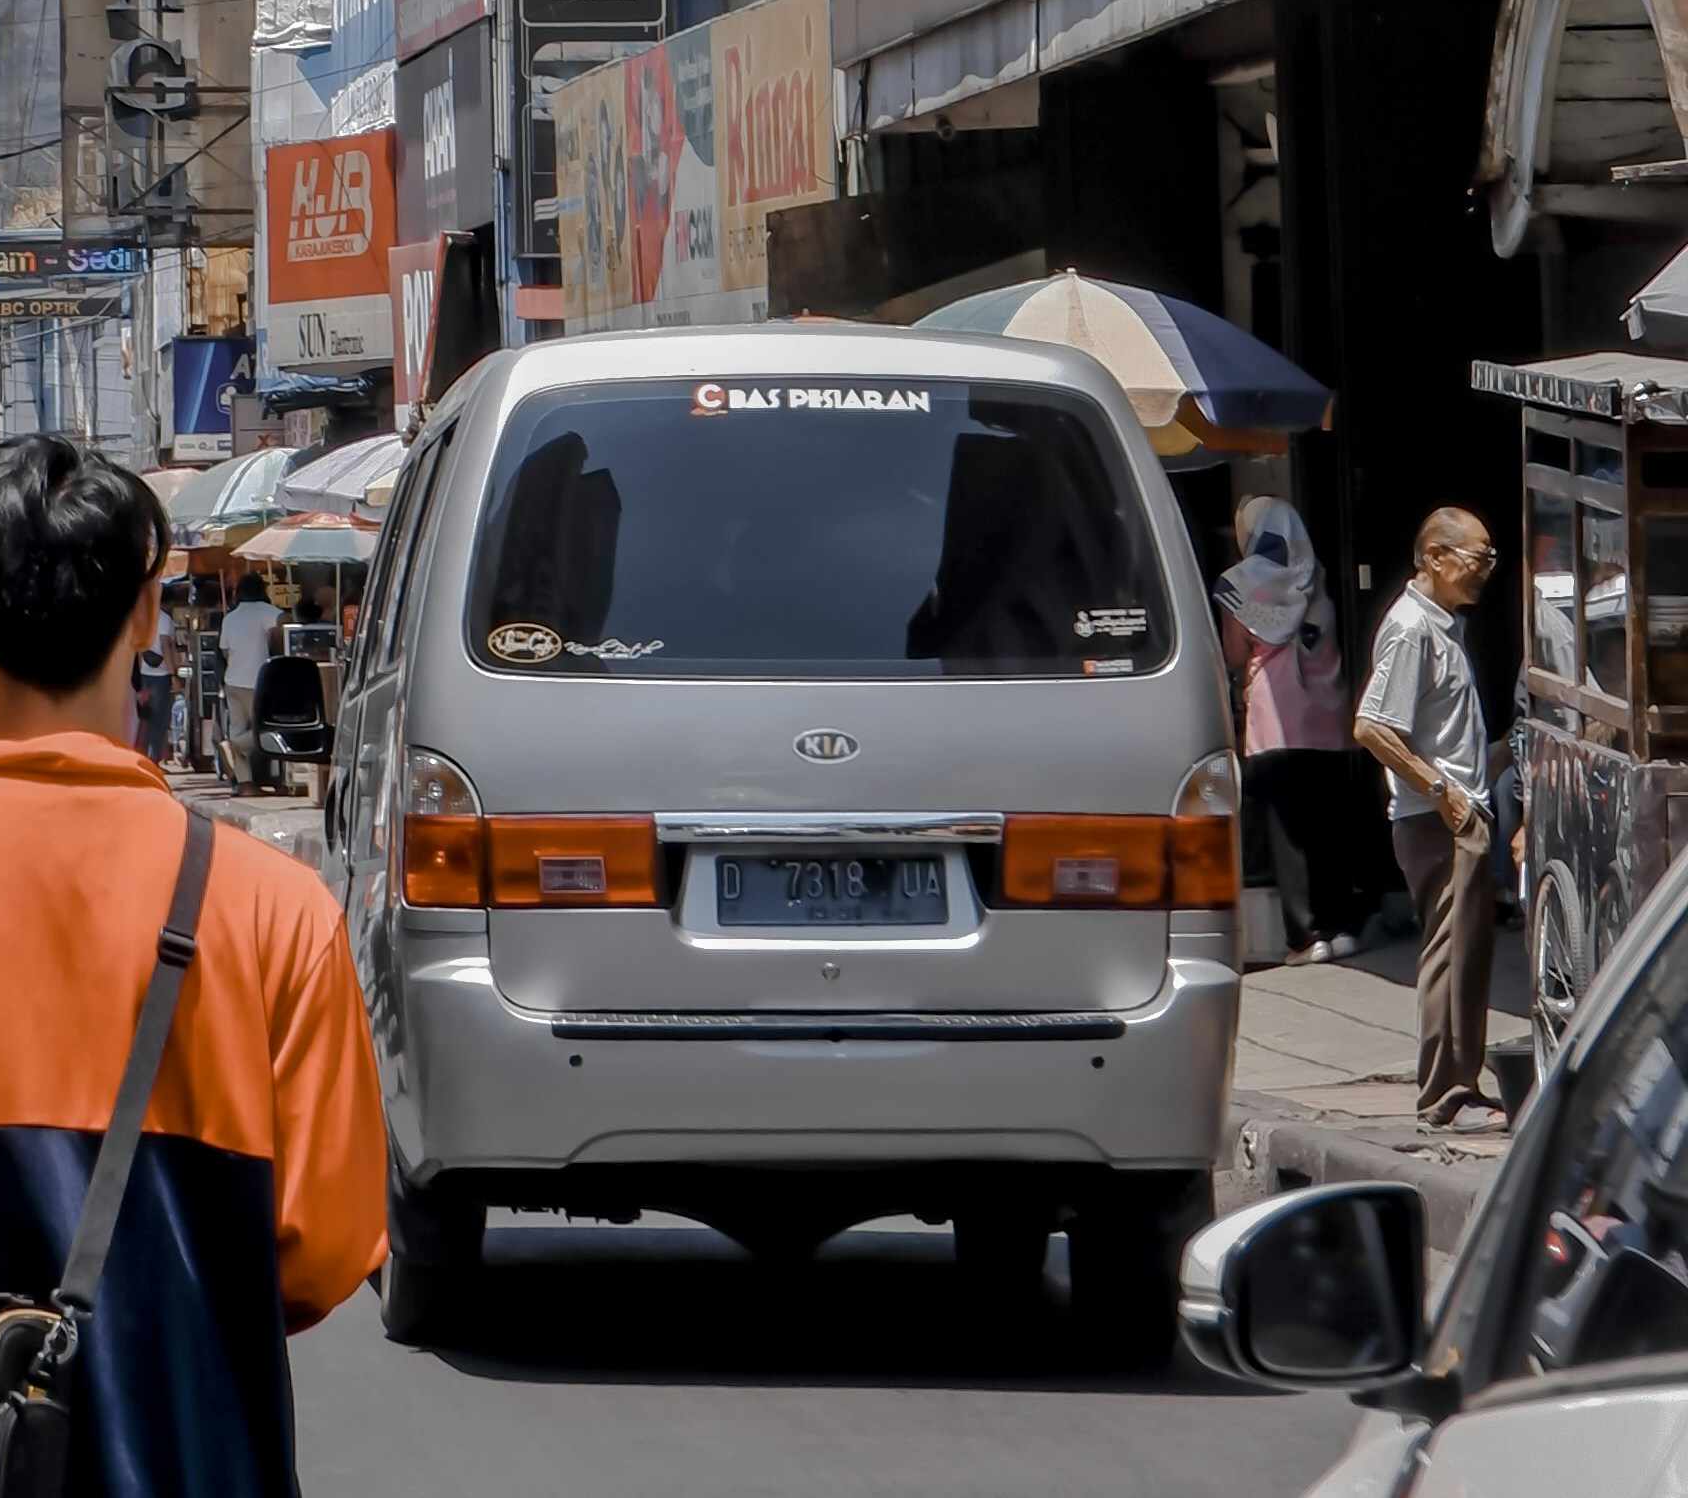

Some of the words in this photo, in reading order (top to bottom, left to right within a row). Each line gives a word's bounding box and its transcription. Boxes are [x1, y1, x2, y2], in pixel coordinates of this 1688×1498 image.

[724, 12, 818, 207] Rinnai
[29, 301, 81, 316] OPTIK
[299, 312, 327, 358] SUN
[728, 388, 782, 409] BAS
[804, 735, 851, 756] KIA
[723, 862, 741, 901] D
[785, 861, 863, 901] 7318
[902, 861, 942, 899] UA
